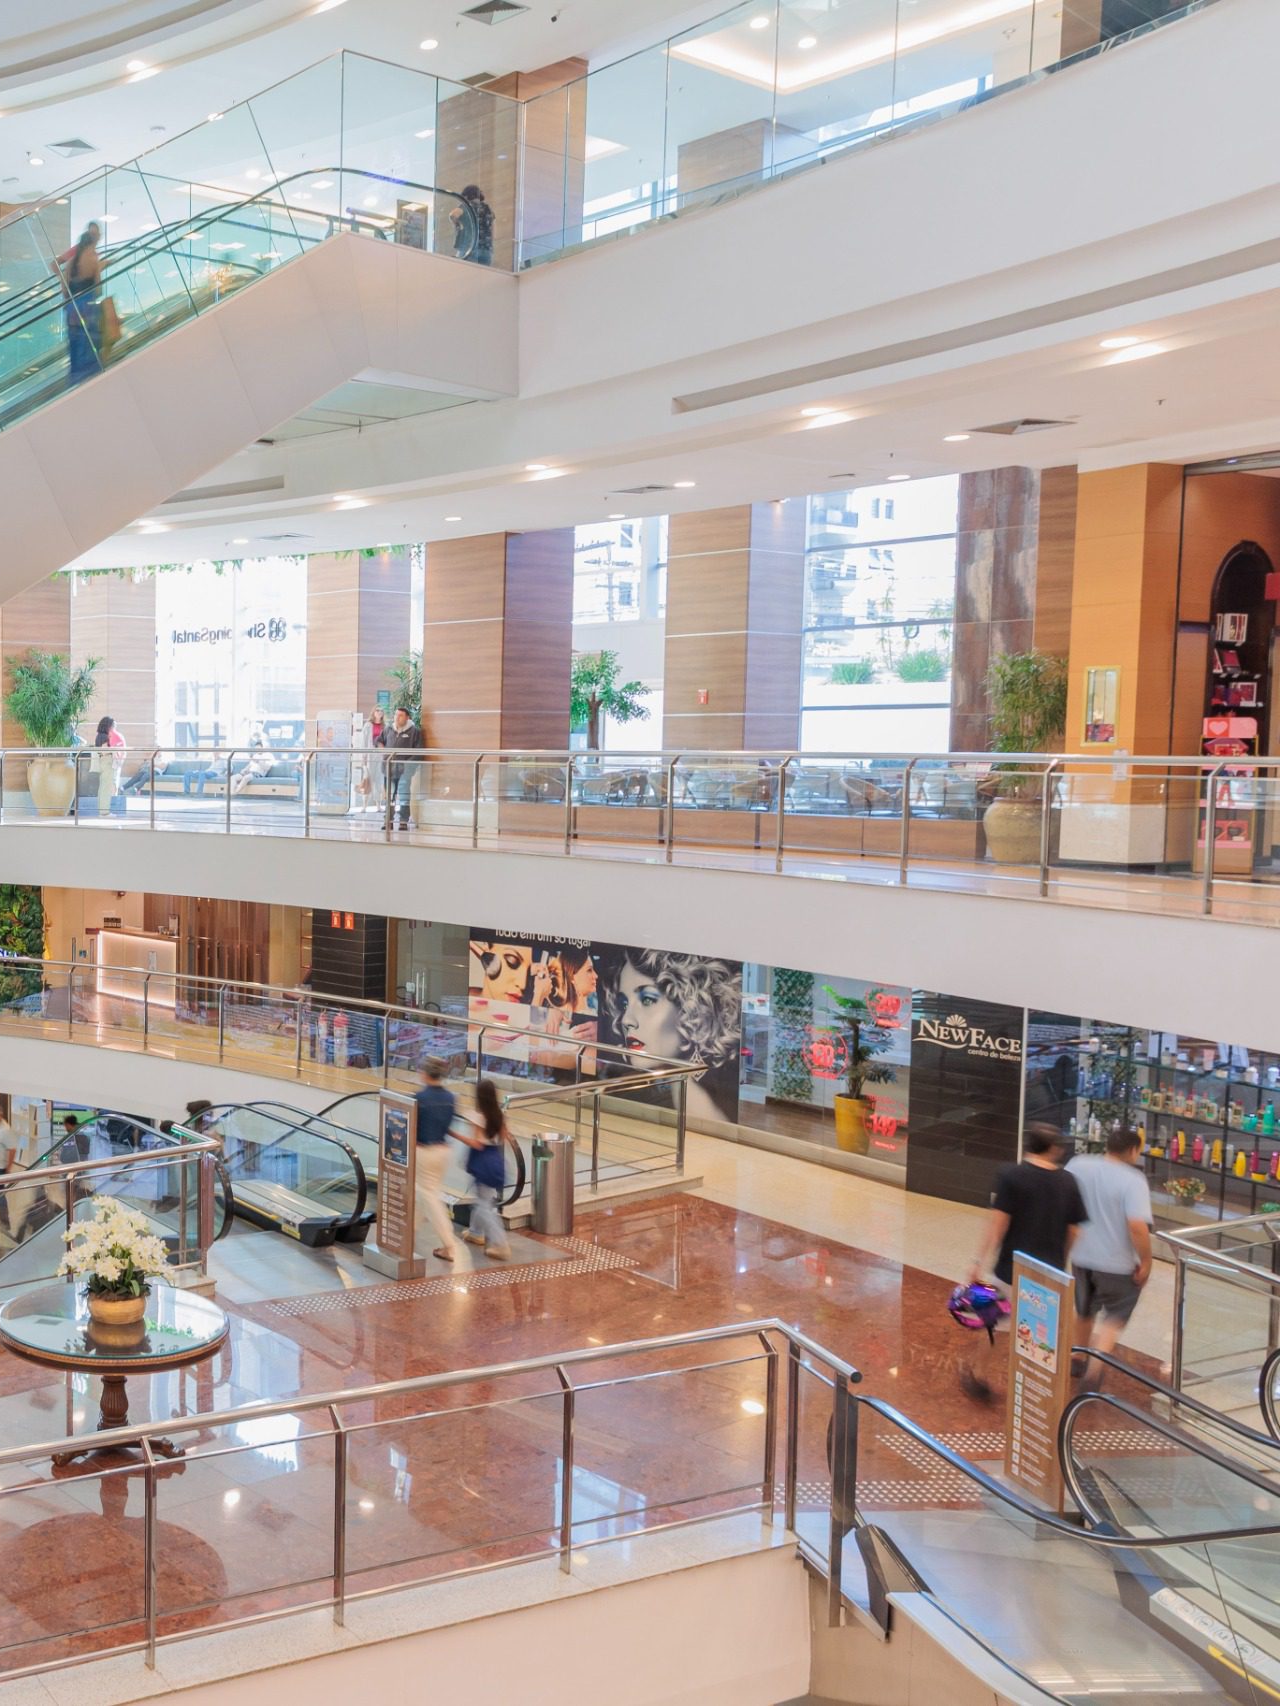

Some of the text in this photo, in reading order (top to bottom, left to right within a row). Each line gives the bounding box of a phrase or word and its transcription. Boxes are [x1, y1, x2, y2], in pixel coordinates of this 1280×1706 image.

[967, 1049, 1021, 1062] centro de beleza
